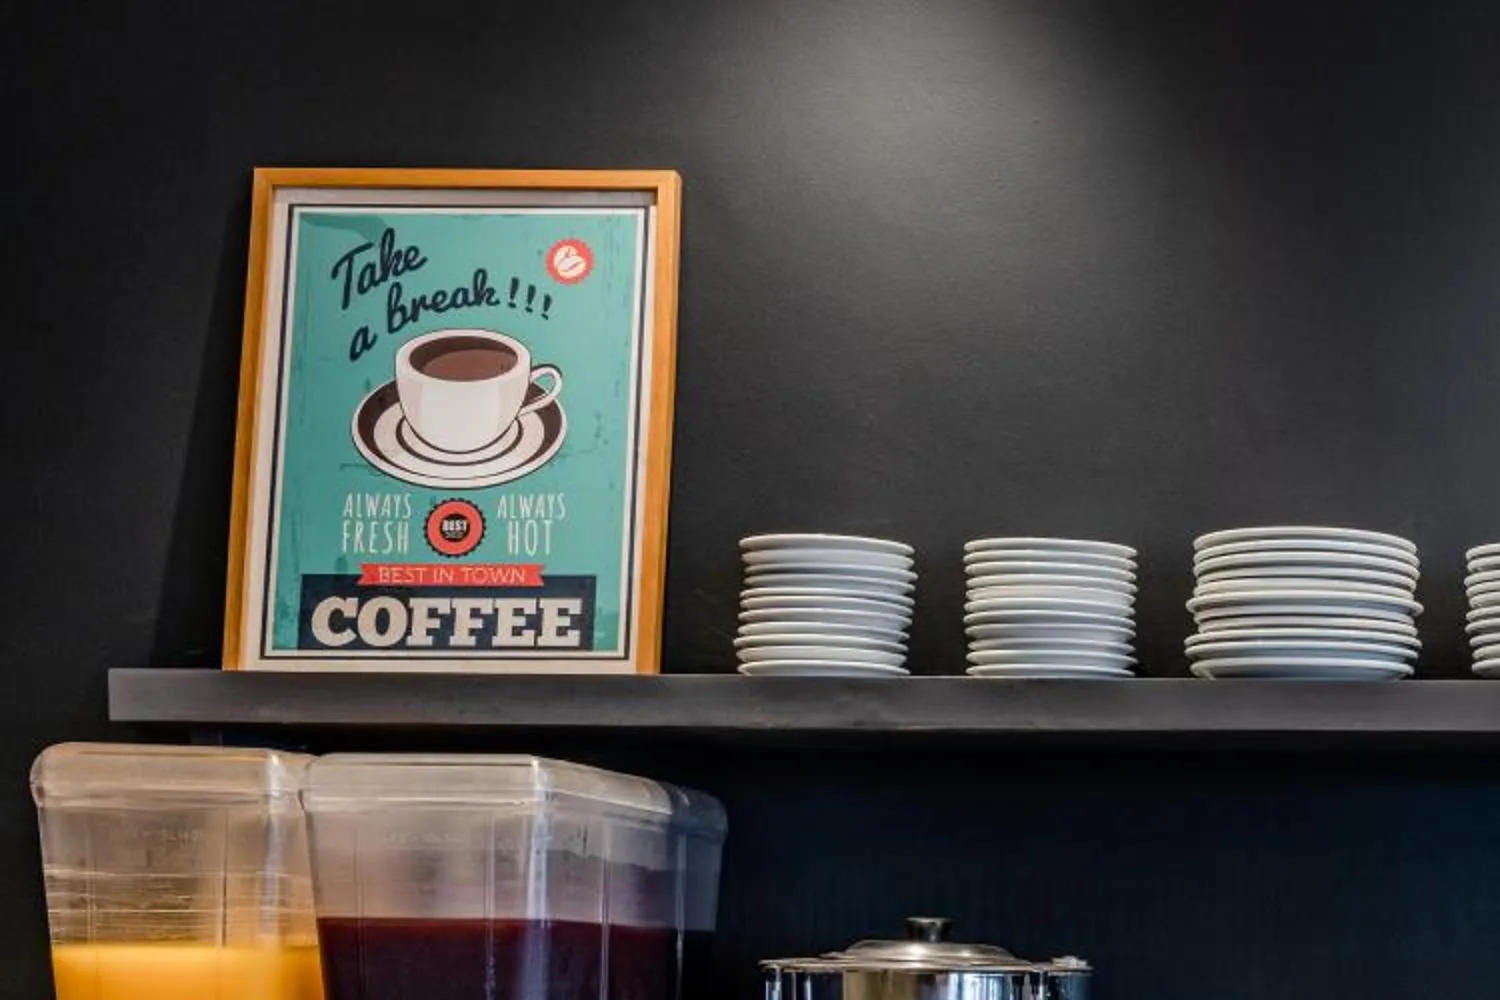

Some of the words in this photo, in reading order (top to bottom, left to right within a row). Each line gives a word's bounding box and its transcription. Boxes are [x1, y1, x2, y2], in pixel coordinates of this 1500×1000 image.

[331, 227, 428, 311] Take
[350, 325, 378, 361] a
[342, 492, 412, 520] ALWAYS
[497, 492, 567, 520] ALWAYS
[341, 520, 411, 556] FRESH
[507, 520, 554, 556] HOT
[378, 567, 428, 584] BEST
[433, 568, 453, 584] IN
[461, 568, 526, 585] TOWN
[311, 595, 582, 648] COFFEE
